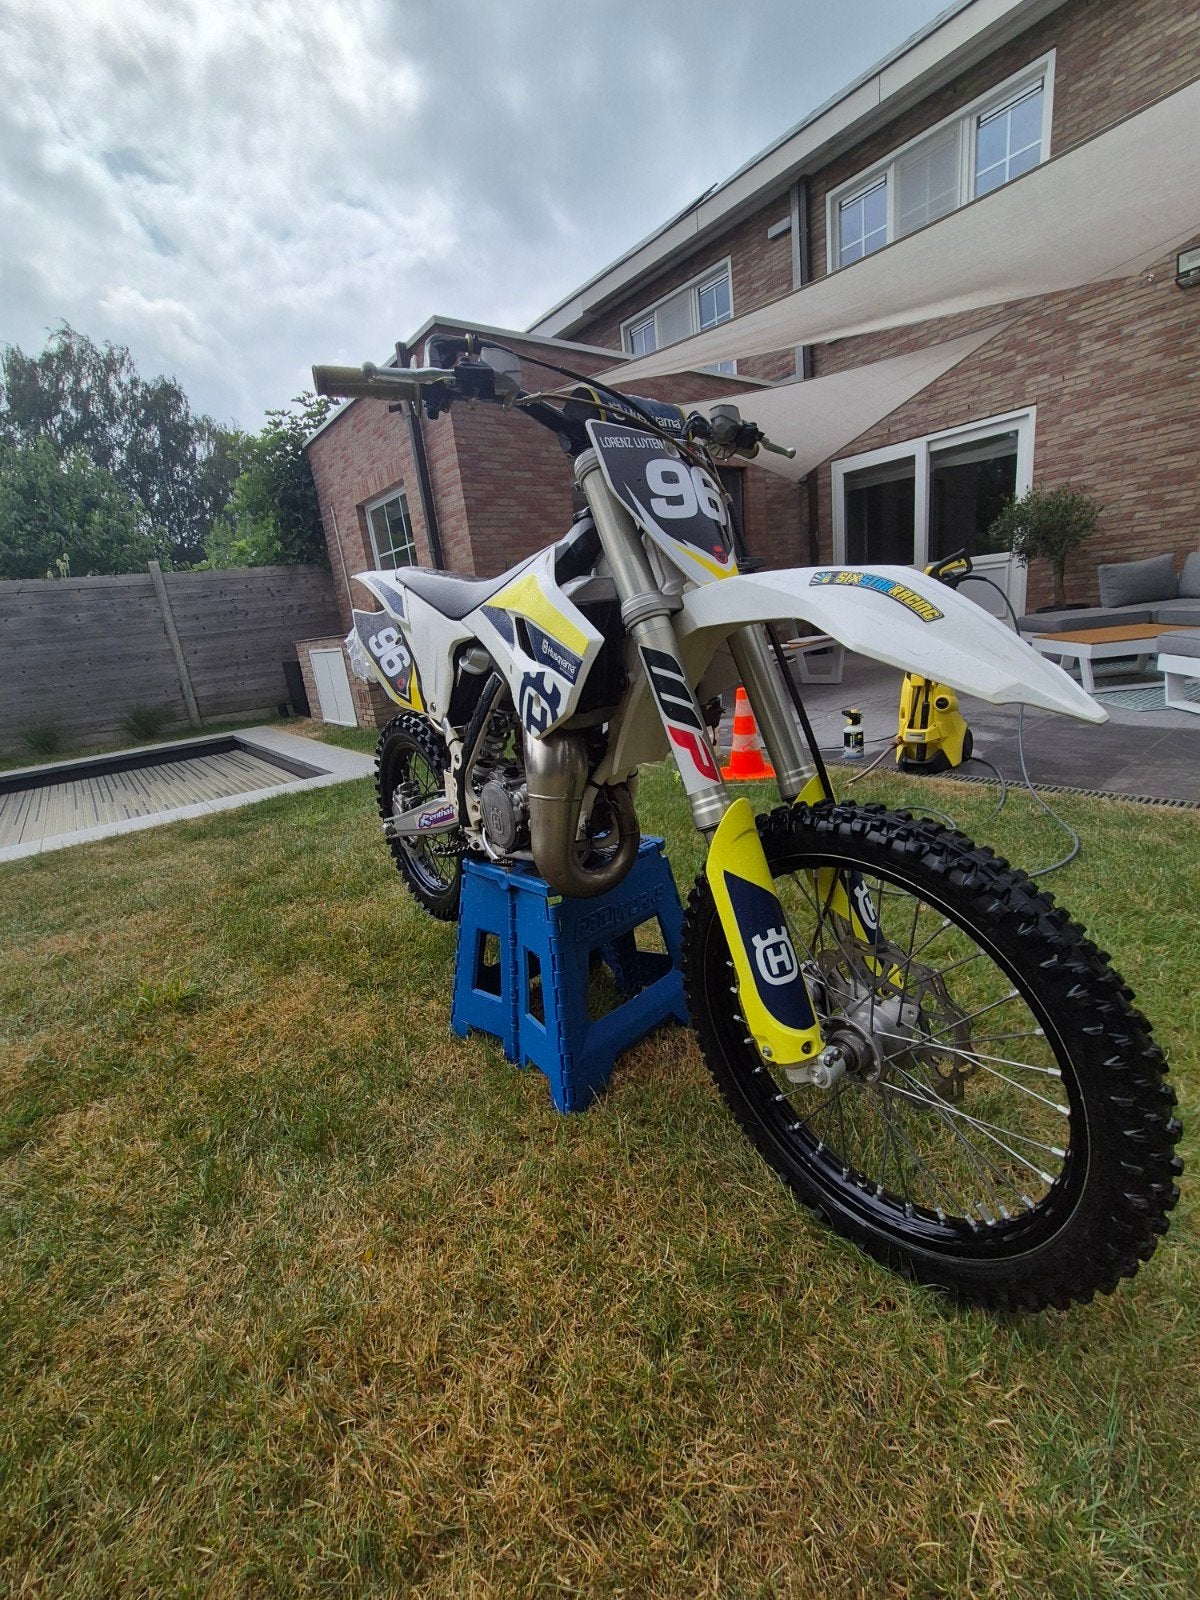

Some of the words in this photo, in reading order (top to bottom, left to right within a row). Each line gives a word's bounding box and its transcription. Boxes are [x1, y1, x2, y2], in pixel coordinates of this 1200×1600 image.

[600, 437, 633, 449] LORENZ
[634, 438, 664, 450] LUYTEN
[645, 458, 727, 526] 96
[834, 571, 863, 584] SIX
[368, 627, 411, 678] 96
[418, 805, 454, 828] Renthal
